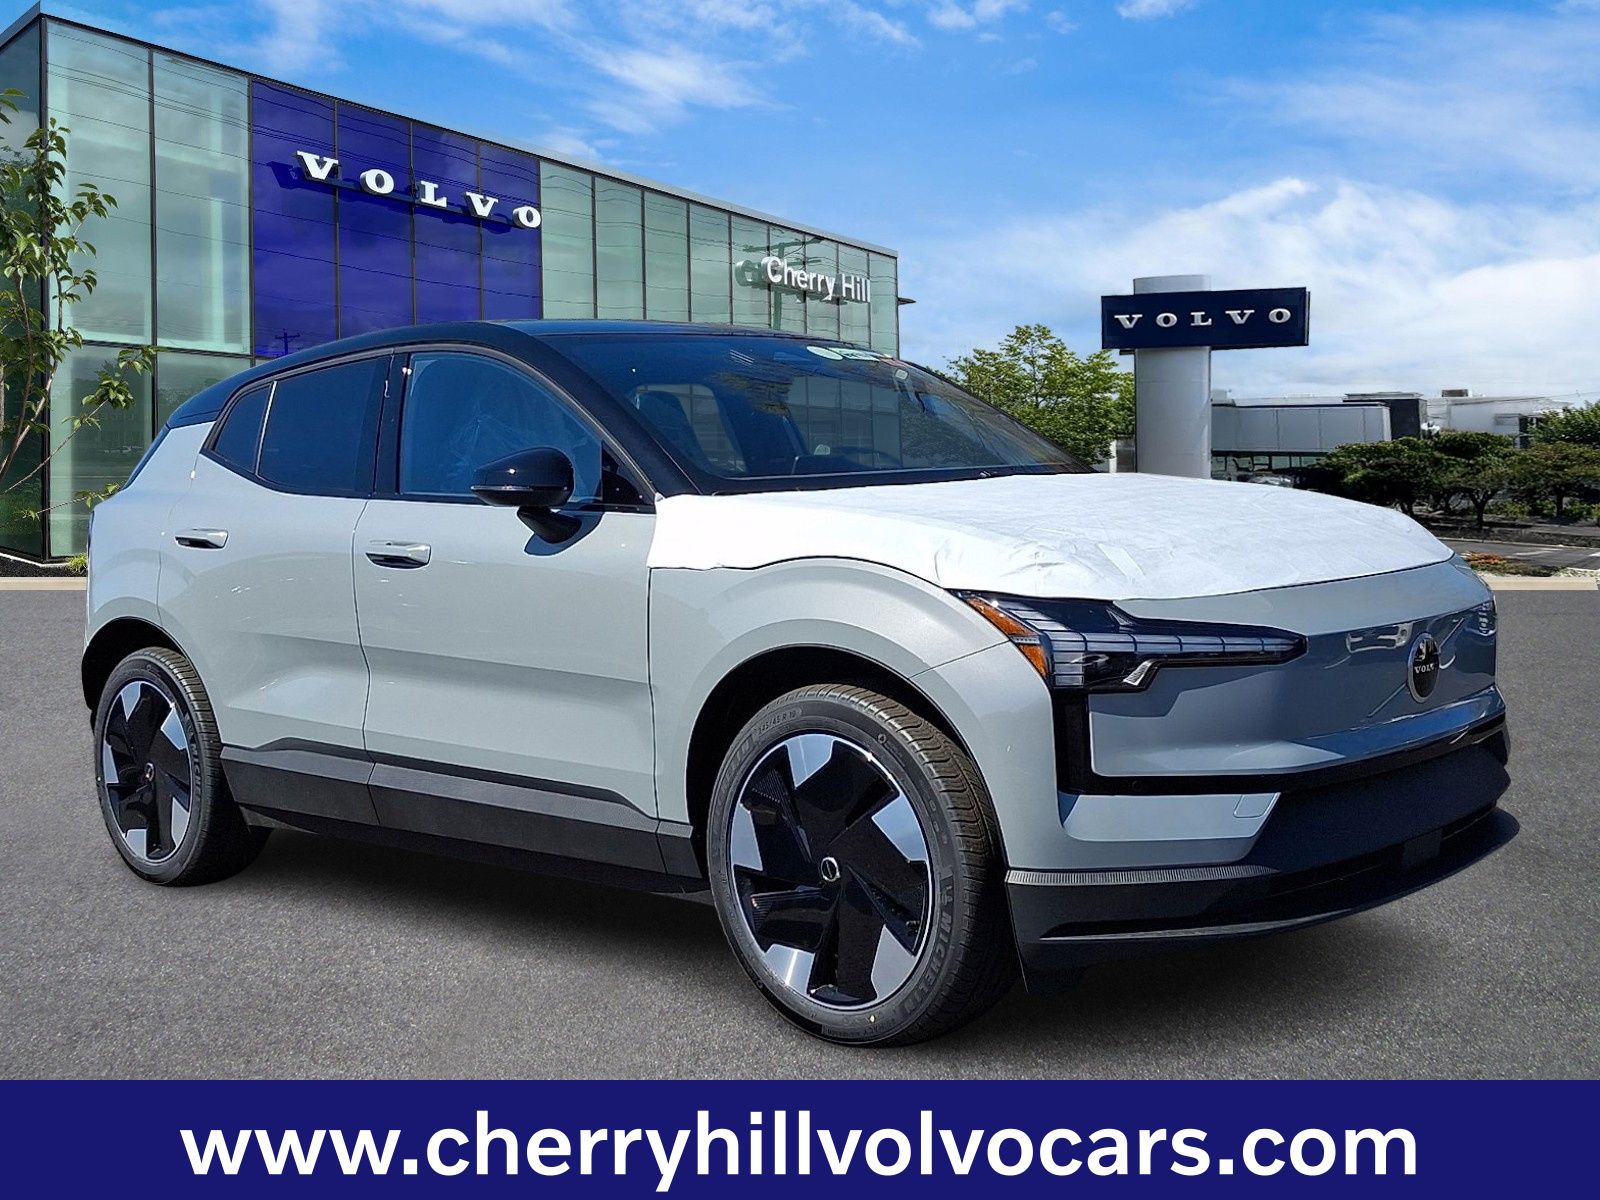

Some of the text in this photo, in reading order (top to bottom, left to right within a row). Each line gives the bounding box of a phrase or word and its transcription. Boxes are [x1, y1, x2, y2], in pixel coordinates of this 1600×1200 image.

[296, 150, 542, 229] VOLVO
[763, 257, 872, 303] Cherry Hill
[1114, 308, 1292, 330] VOLVO
[903, 910, 952, 1014] MICHELIN
